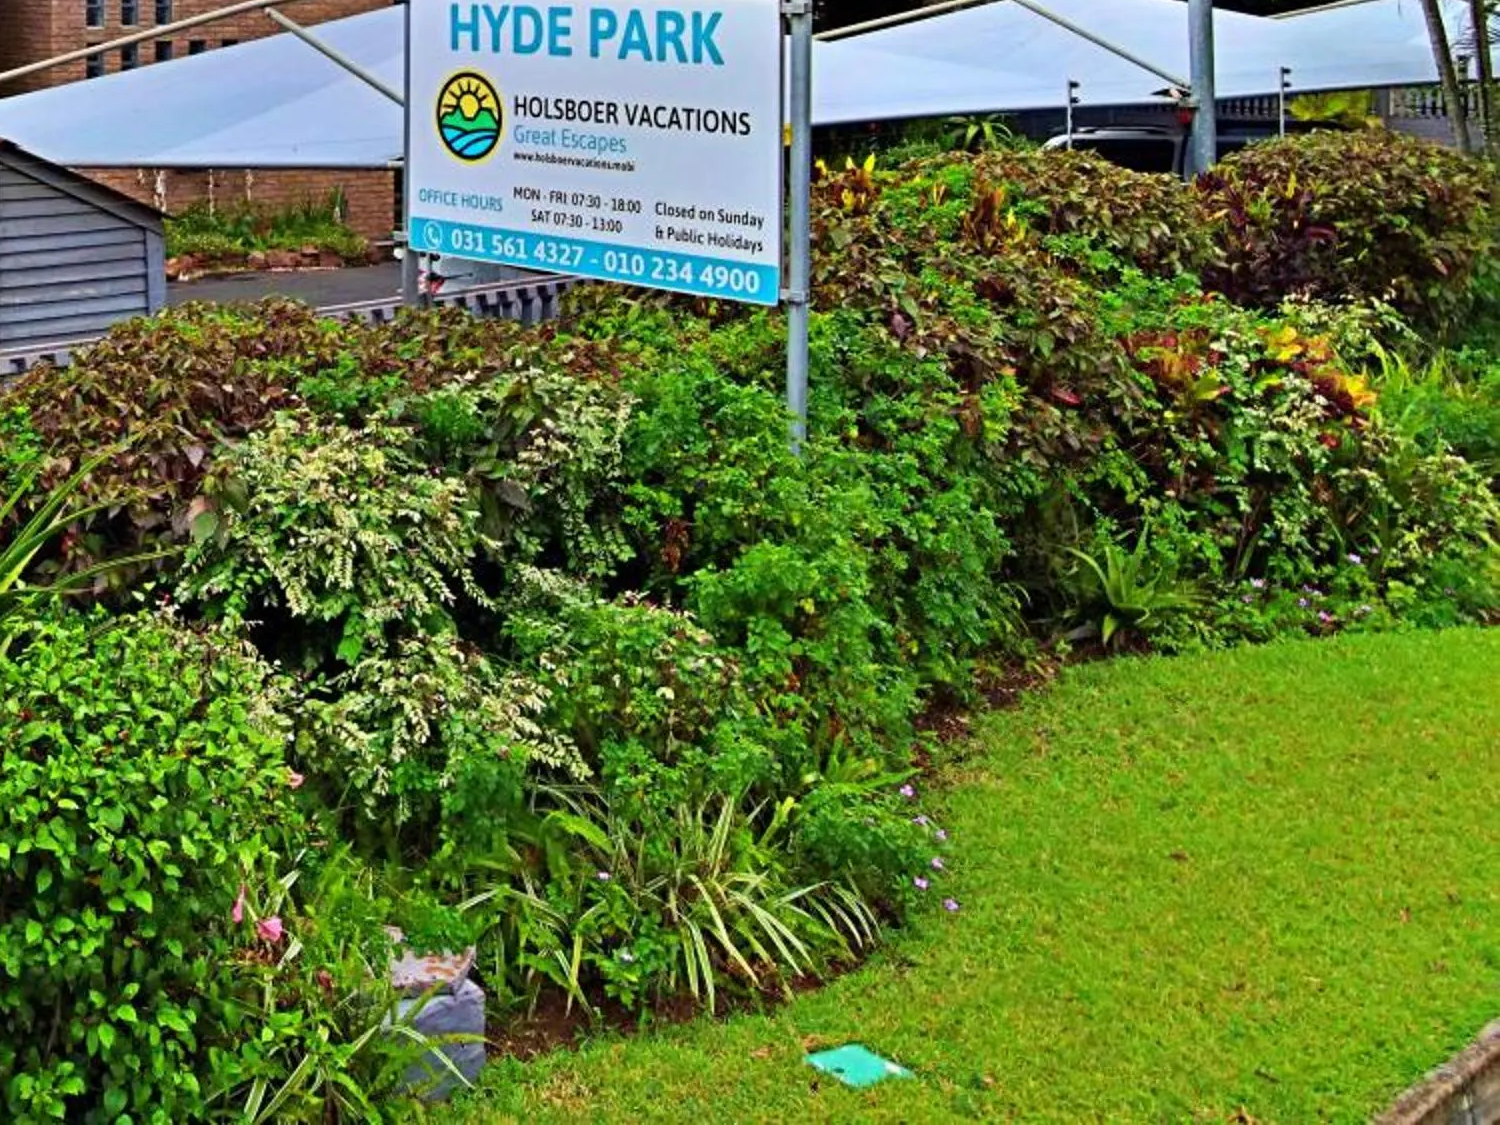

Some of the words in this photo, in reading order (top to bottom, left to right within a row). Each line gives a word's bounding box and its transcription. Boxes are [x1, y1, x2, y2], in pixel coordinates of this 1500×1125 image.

[449, 2, 573, 58] HYDE
[589, 7, 725, 66] PARK
[513, 94, 619, 126] HOLSBOER
[624, 102, 751, 136] VACATIONS
[513, 124, 556, 147] Great
[561, 128, 627, 156] Escapes
[418, 187, 457, 207] OFFICE
[461, 193, 503, 212] HOURS
[513, 186, 541, 201] MON
[571, 192, 601, 210] 07:30
[611, 197, 642, 214] 18:00
[531, 208, 551, 224] SAT
[553, 211, 583, 228] 07:30
[655, 202, 695, 220] Closed
[699, 209, 715, 222] on
[717, 208, 764, 230] Sunday
[667, 226, 705, 246] Public
[707, 232, 763, 255] Holidays
[451, 229, 485, 253] 031
[491, 236, 527, 259] 561
[533, 242, 584, 268] 4327
[603, 250, 645, 277] 010
[651, 256, 694, 284] 234
[699, 263, 760, 293] 4900
